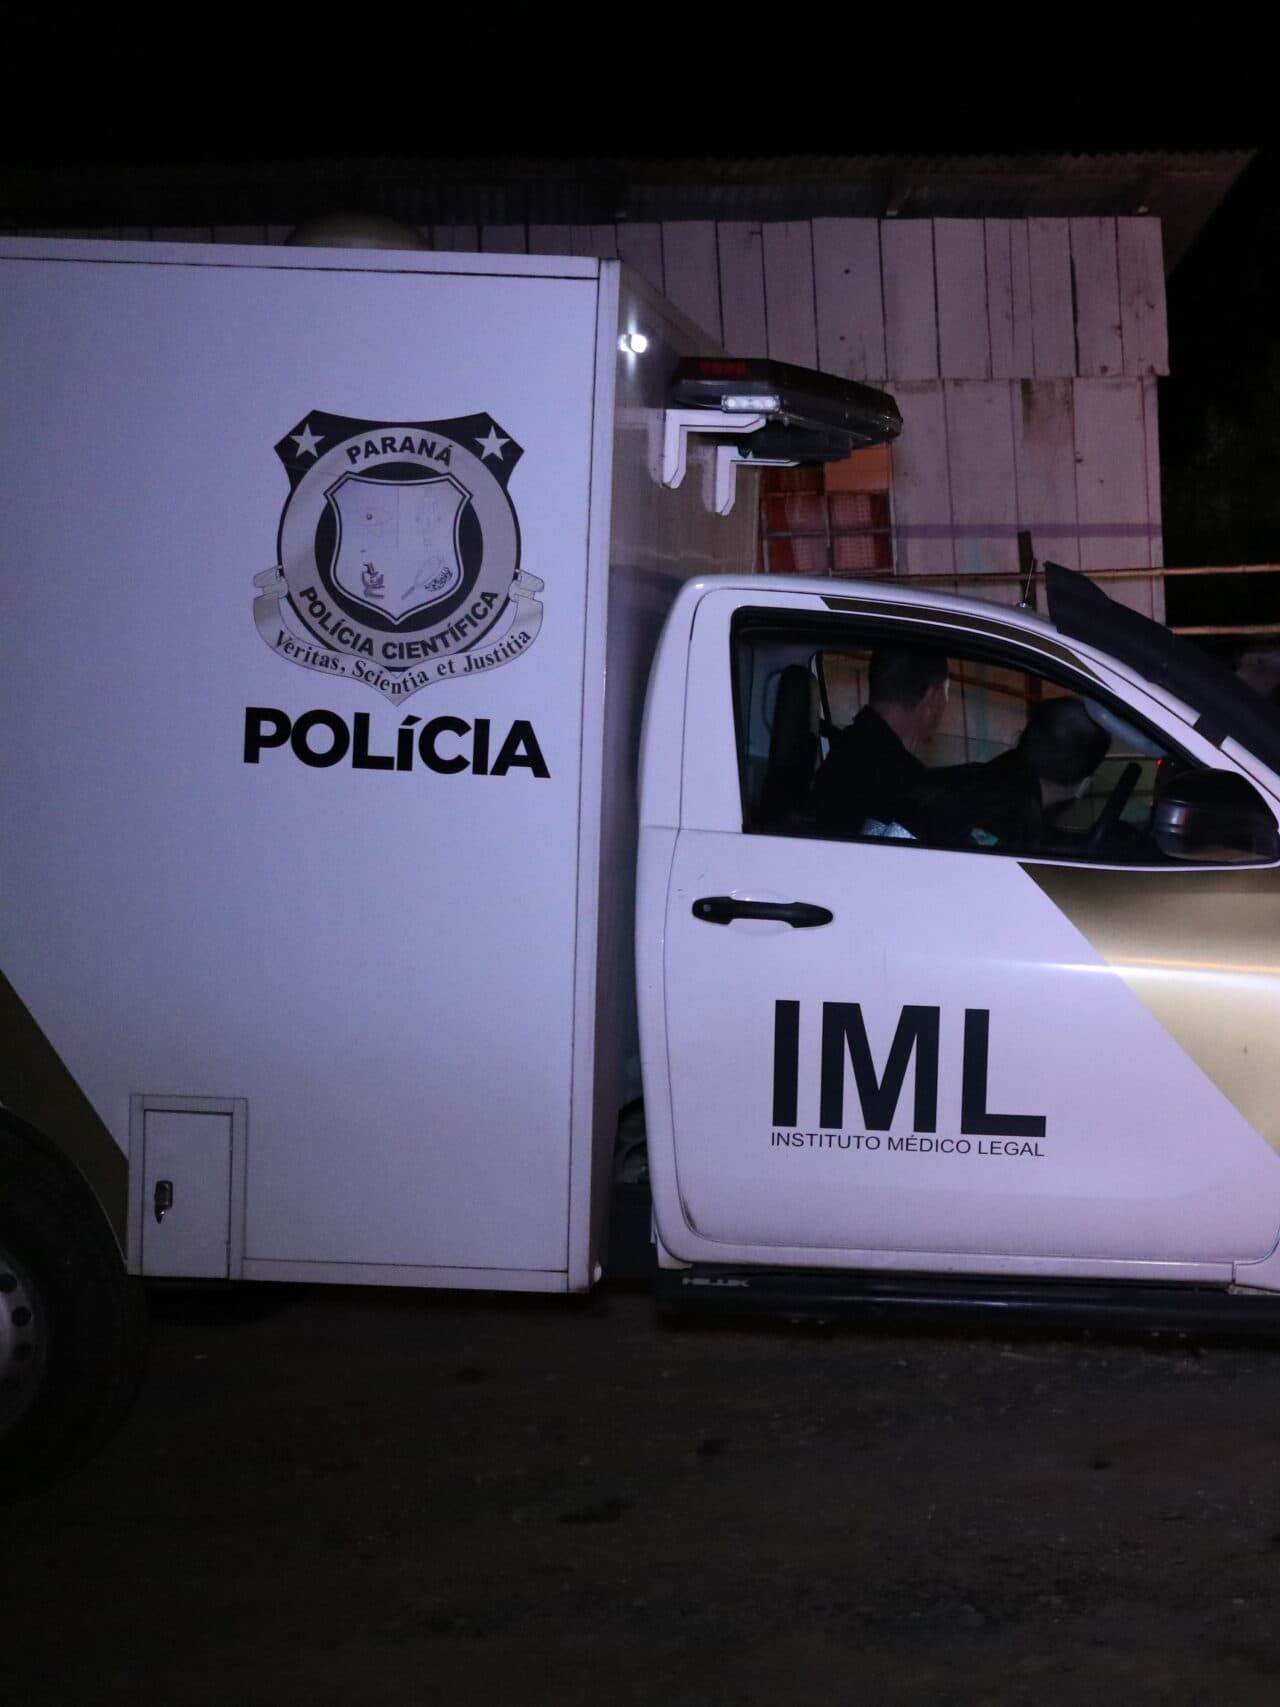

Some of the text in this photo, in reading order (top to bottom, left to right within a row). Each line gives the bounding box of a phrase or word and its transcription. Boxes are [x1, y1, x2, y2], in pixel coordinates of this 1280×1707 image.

[346, 436, 452, 465] PARANÁ
[299, 586, 498, 660] POLÍCIA CIENTÍFICA
[275, 629, 531, 694] Veritas, Scientia et Justitia
[771, 1000, 1047, 1138] IML
[771, 1132, 1045, 1157] INSTITUTO MÉDICO LEGAL
